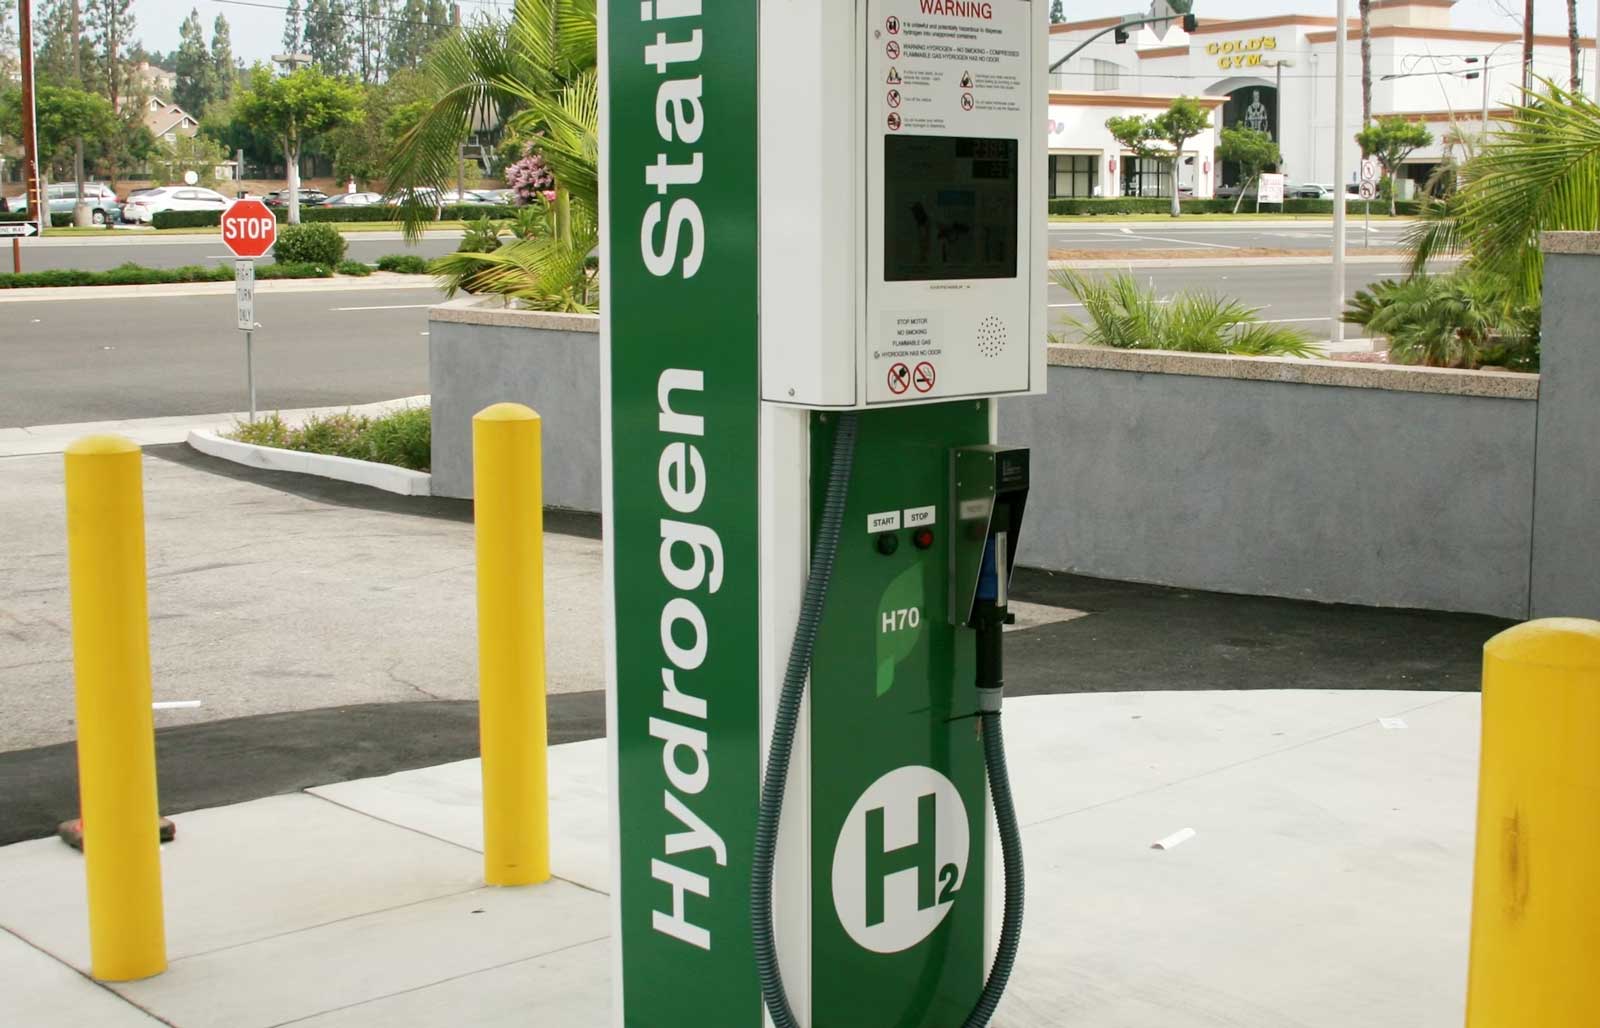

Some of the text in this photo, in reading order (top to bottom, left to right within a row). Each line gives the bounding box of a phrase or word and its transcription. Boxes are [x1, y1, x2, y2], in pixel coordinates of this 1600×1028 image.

[920, 0, 992, 19] WARNING
[1206, 35, 1277, 55] GOLD'S
[903, 51, 931, 59] FLAMMABLE
[989, 49, 1020, 57] COMPRESSED
[1218, 54, 1263, 69] GYM
[225, 217, 273, 240] STOP
[238, 288, 252, 302] TURN
[239, 308, 251, 322] ONLY
[873, 517, 895, 527] START
[911, 512, 929, 522] STOP
[881, 607, 920, 633] H70
[649, 368, 727, 951] Hydrogen
